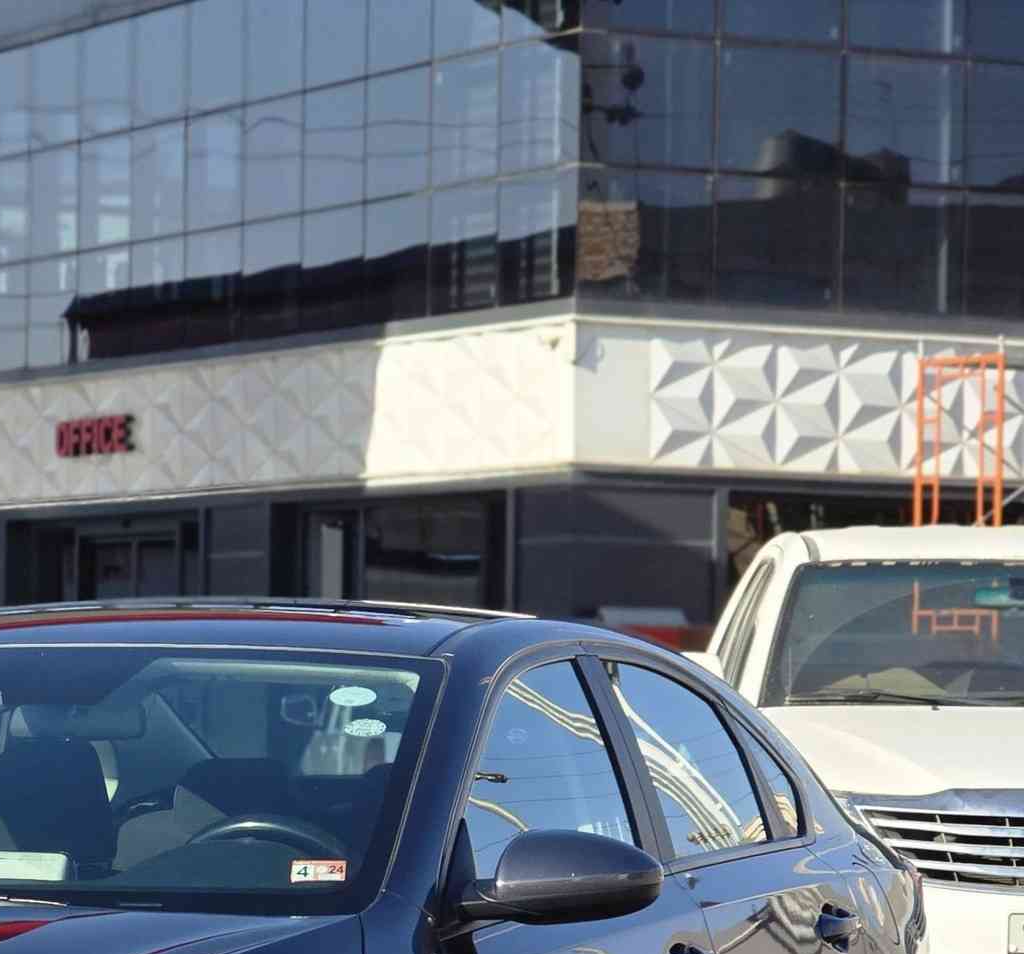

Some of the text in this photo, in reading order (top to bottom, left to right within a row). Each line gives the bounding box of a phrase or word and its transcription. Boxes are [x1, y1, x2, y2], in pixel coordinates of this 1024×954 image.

[54, 414, 133, 458] OFFICE
[296, 865, 344, 877] 4 24
